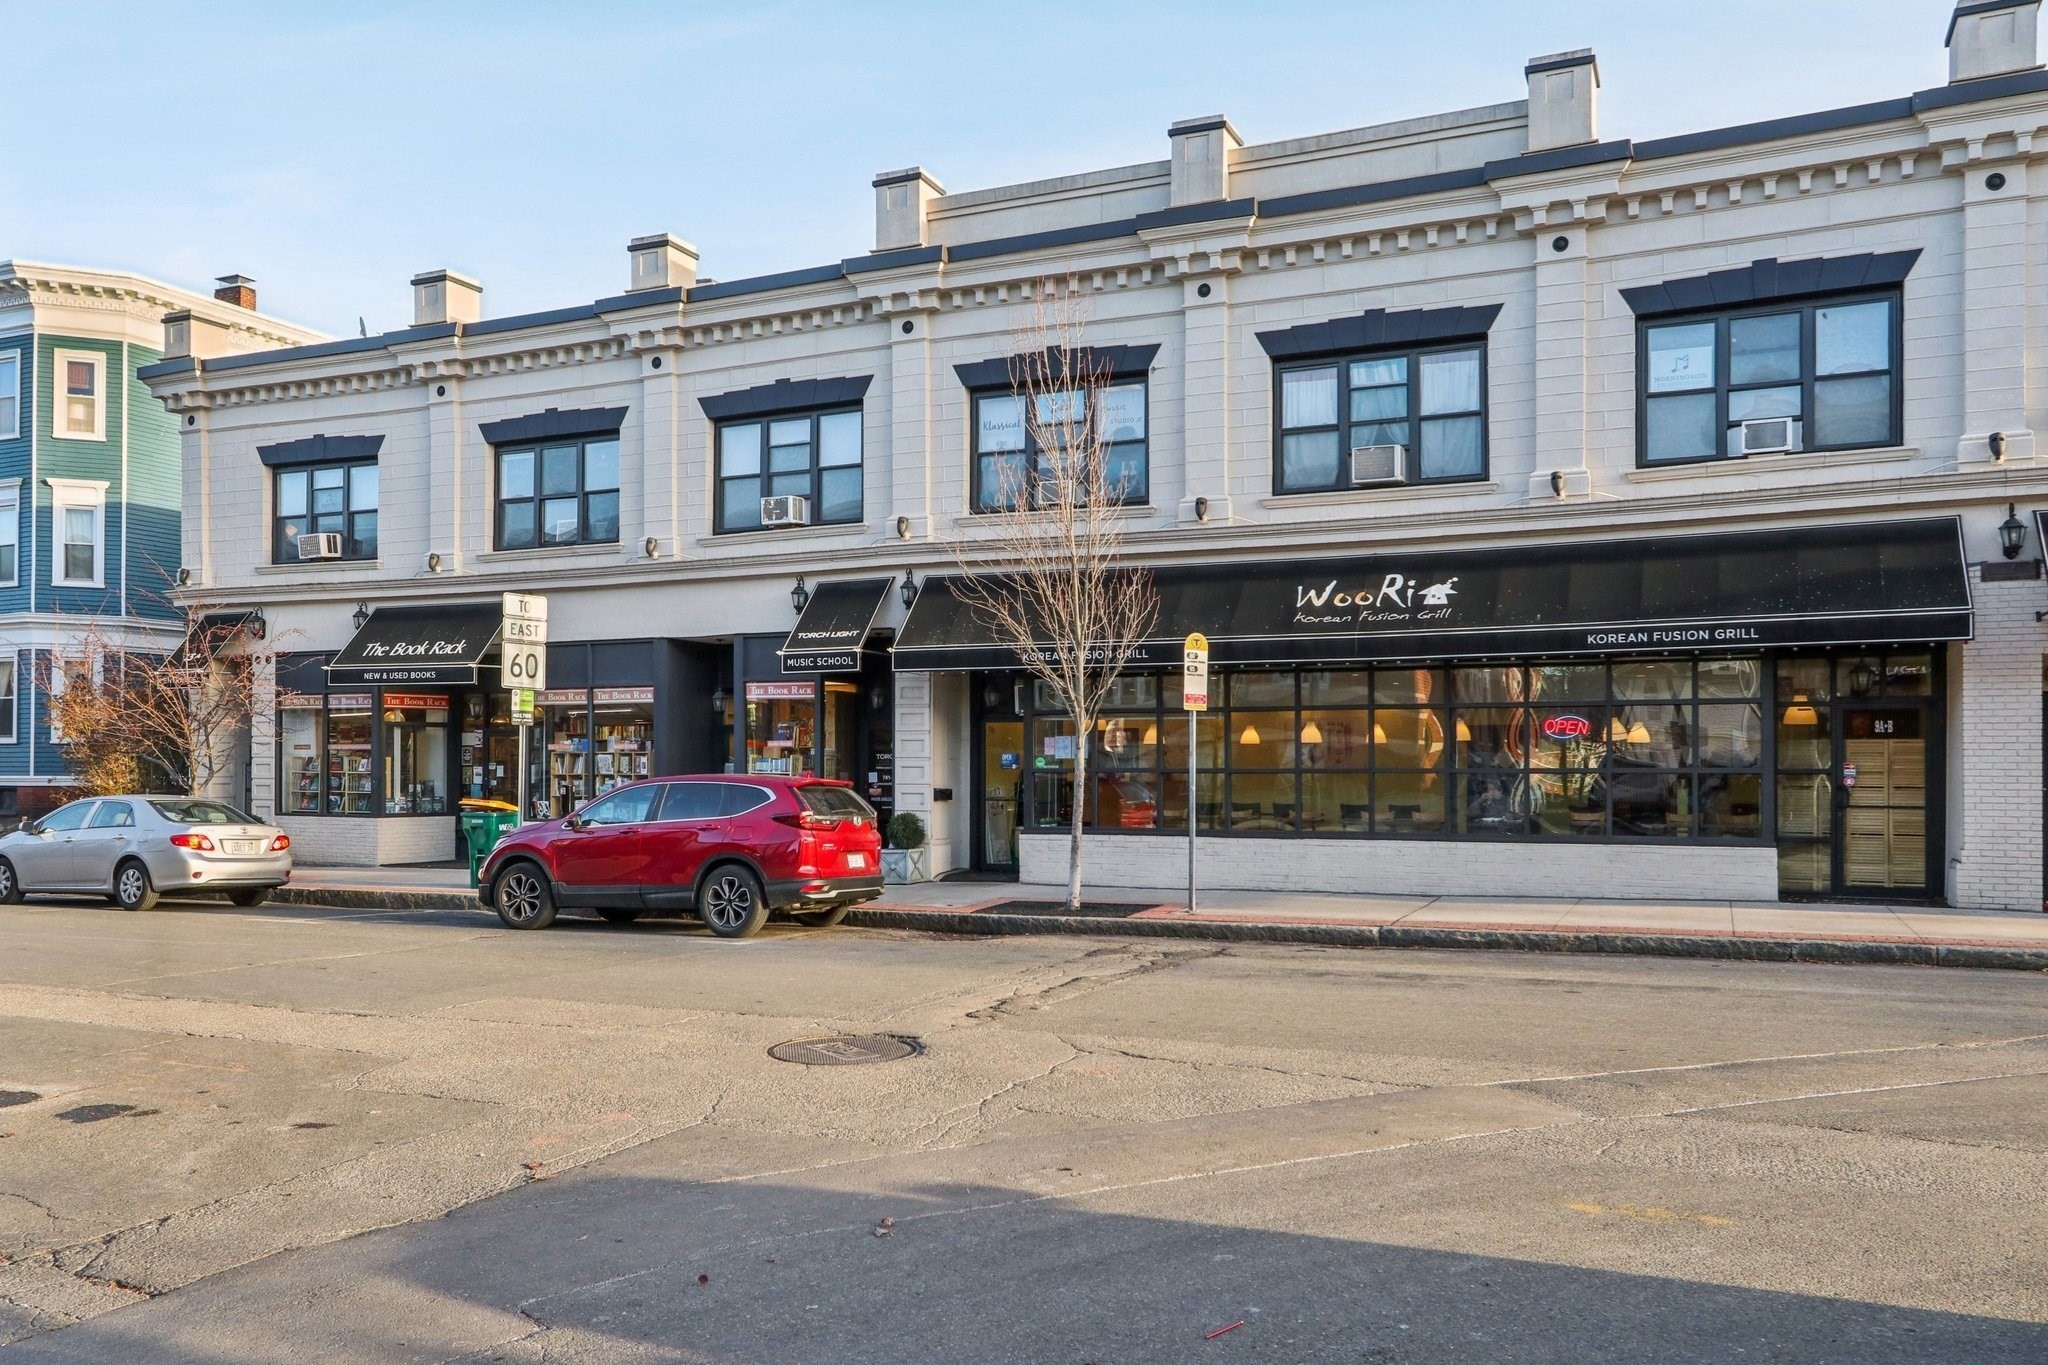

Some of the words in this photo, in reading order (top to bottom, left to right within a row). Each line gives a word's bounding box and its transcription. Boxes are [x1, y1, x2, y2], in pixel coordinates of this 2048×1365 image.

[983, 417, 1023, 431] Klassical
[1296, 573, 1417, 608] WooRi
[518, 600, 531, 613] TO
[1293, 612, 1351, 623] Korean
[1359, 610, 1410, 622] Fusion
[1417, 608, 1452, 620] Grill
[510, 622, 539, 637] EAST
[797, 631, 831, 639] TORCH
[830, 630, 860, 638] LIGHT
[1587, 632, 1648, 644] KOREAN
[1653, 630, 1709, 642] FUSION
[1715, 628, 1759, 640] GRILL
[362, 642, 390, 656] The
[389, 640, 431, 656] Book
[429, 639, 468, 655] Rack
[510, 653, 538, 679] 60
[787, 658, 814, 667] MUSIC
[816, 656, 854, 666] SCHOOL
[410, 671, 436, 679] BOOKS
[548, 693, 566, 701] BOOK
[568, 692, 587, 700] RACK
[612, 691, 631, 700] BOOK
[633, 691, 653, 699] RACK
[768, 686, 788, 695] BOOK
[791, 685, 812, 694] RACK
[404, 697, 424, 706] BOOK
[427, 697, 447, 706] RACK
[1544, 719, 1589, 735] OPEN
